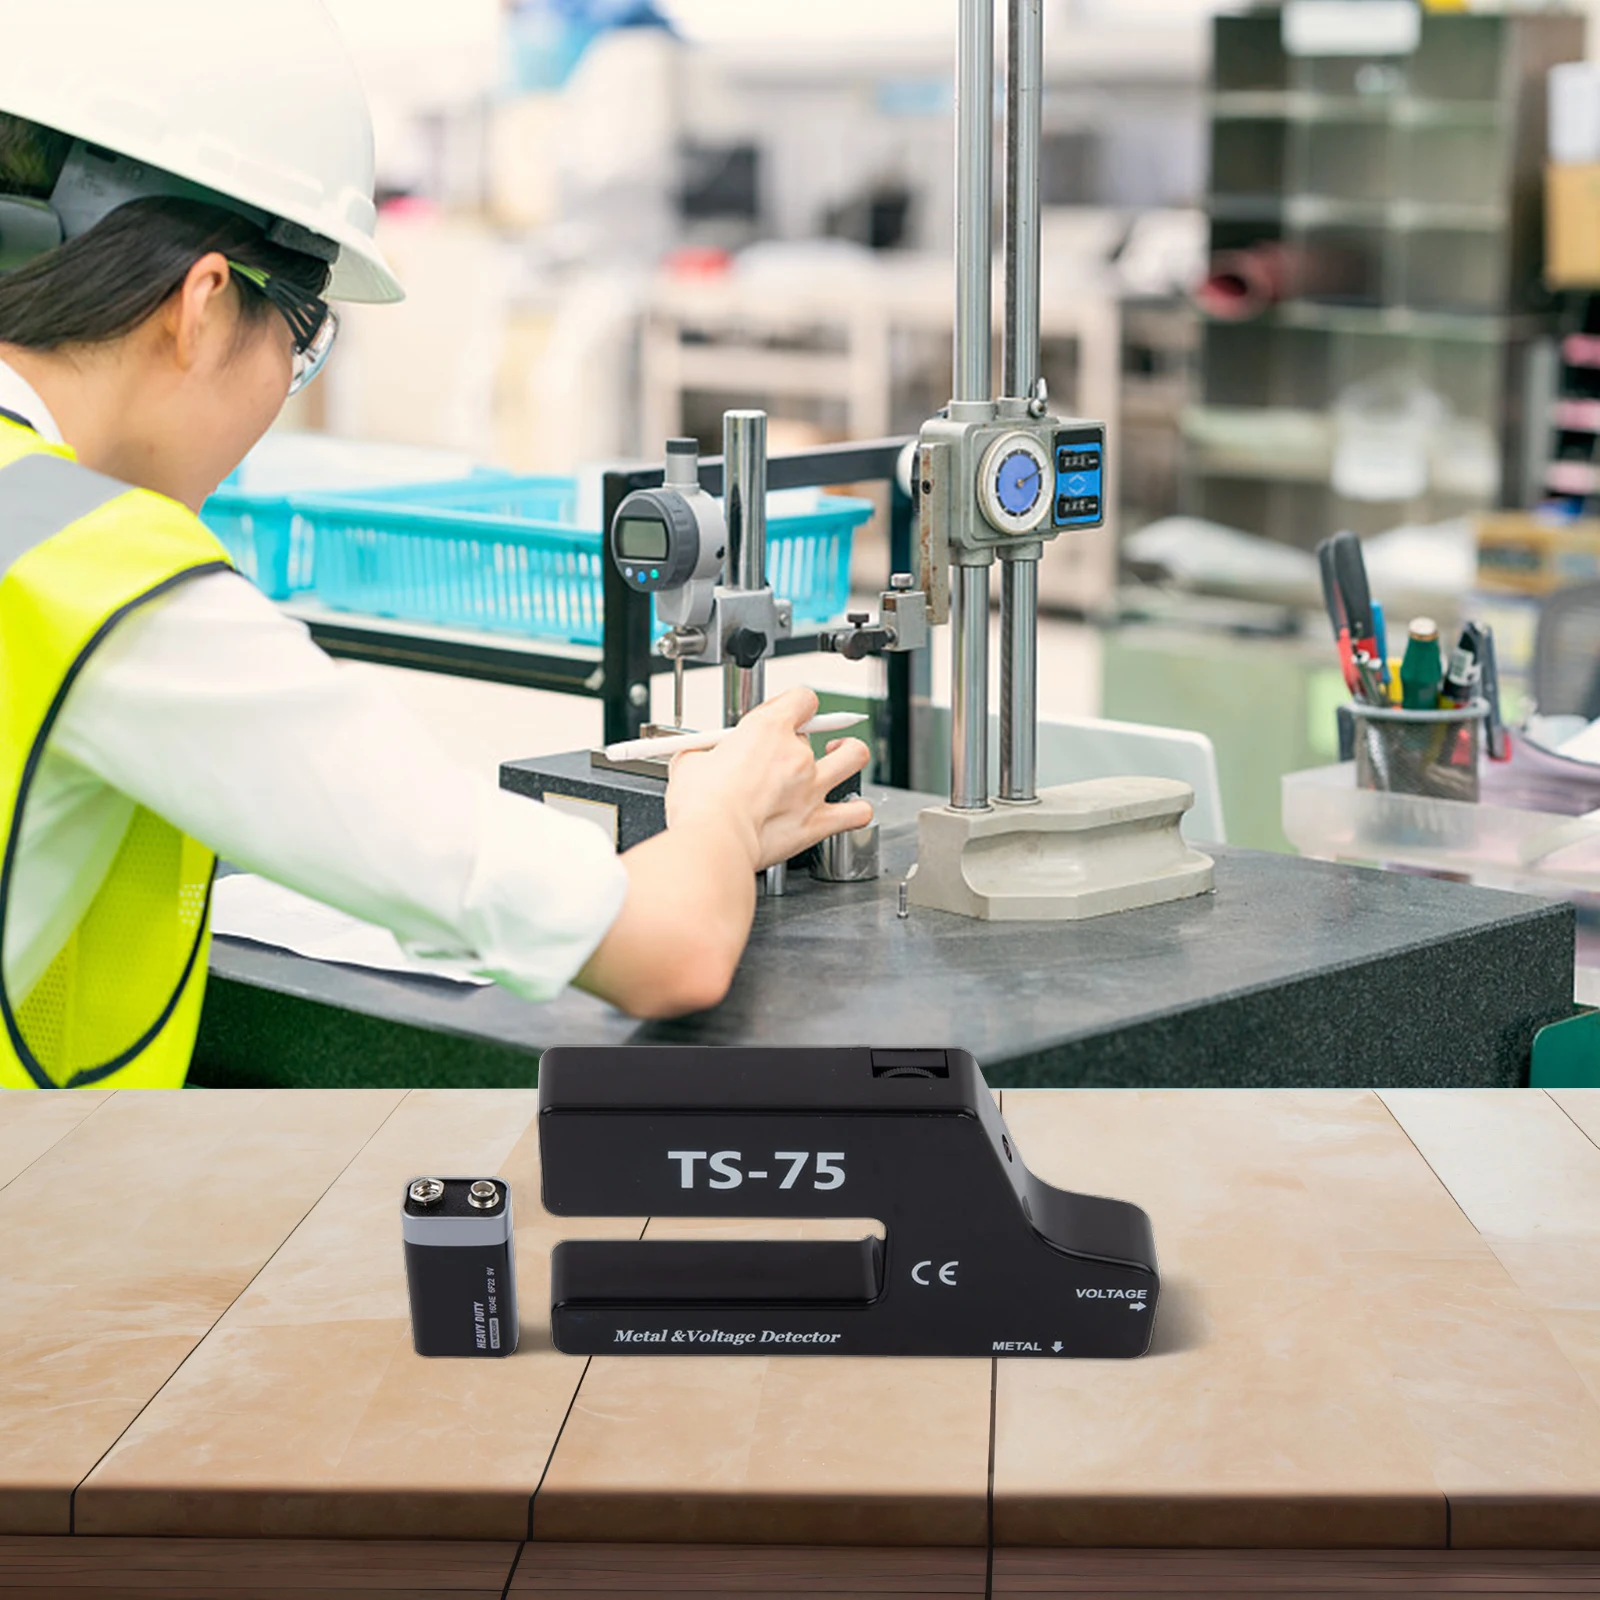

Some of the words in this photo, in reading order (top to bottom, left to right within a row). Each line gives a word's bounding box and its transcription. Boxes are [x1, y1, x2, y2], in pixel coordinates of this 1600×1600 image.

[668, 1151, 846, 1191] TS-75
[486, 1267, 495, 1276] 9V
[911, 1260, 959, 1286] CE
[487, 1278, 496, 1293] 6F22
[1075, 1288, 1148, 1300] VOLTAGE
[473, 1301, 485, 1322] DUTY
[475, 1323, 487, 1349] HEAVY
[614, 1329, 668, 1343] Metal
[759, 1330, 842, 1343] Detector
[992, 1341, 1043, 1352] METAL
